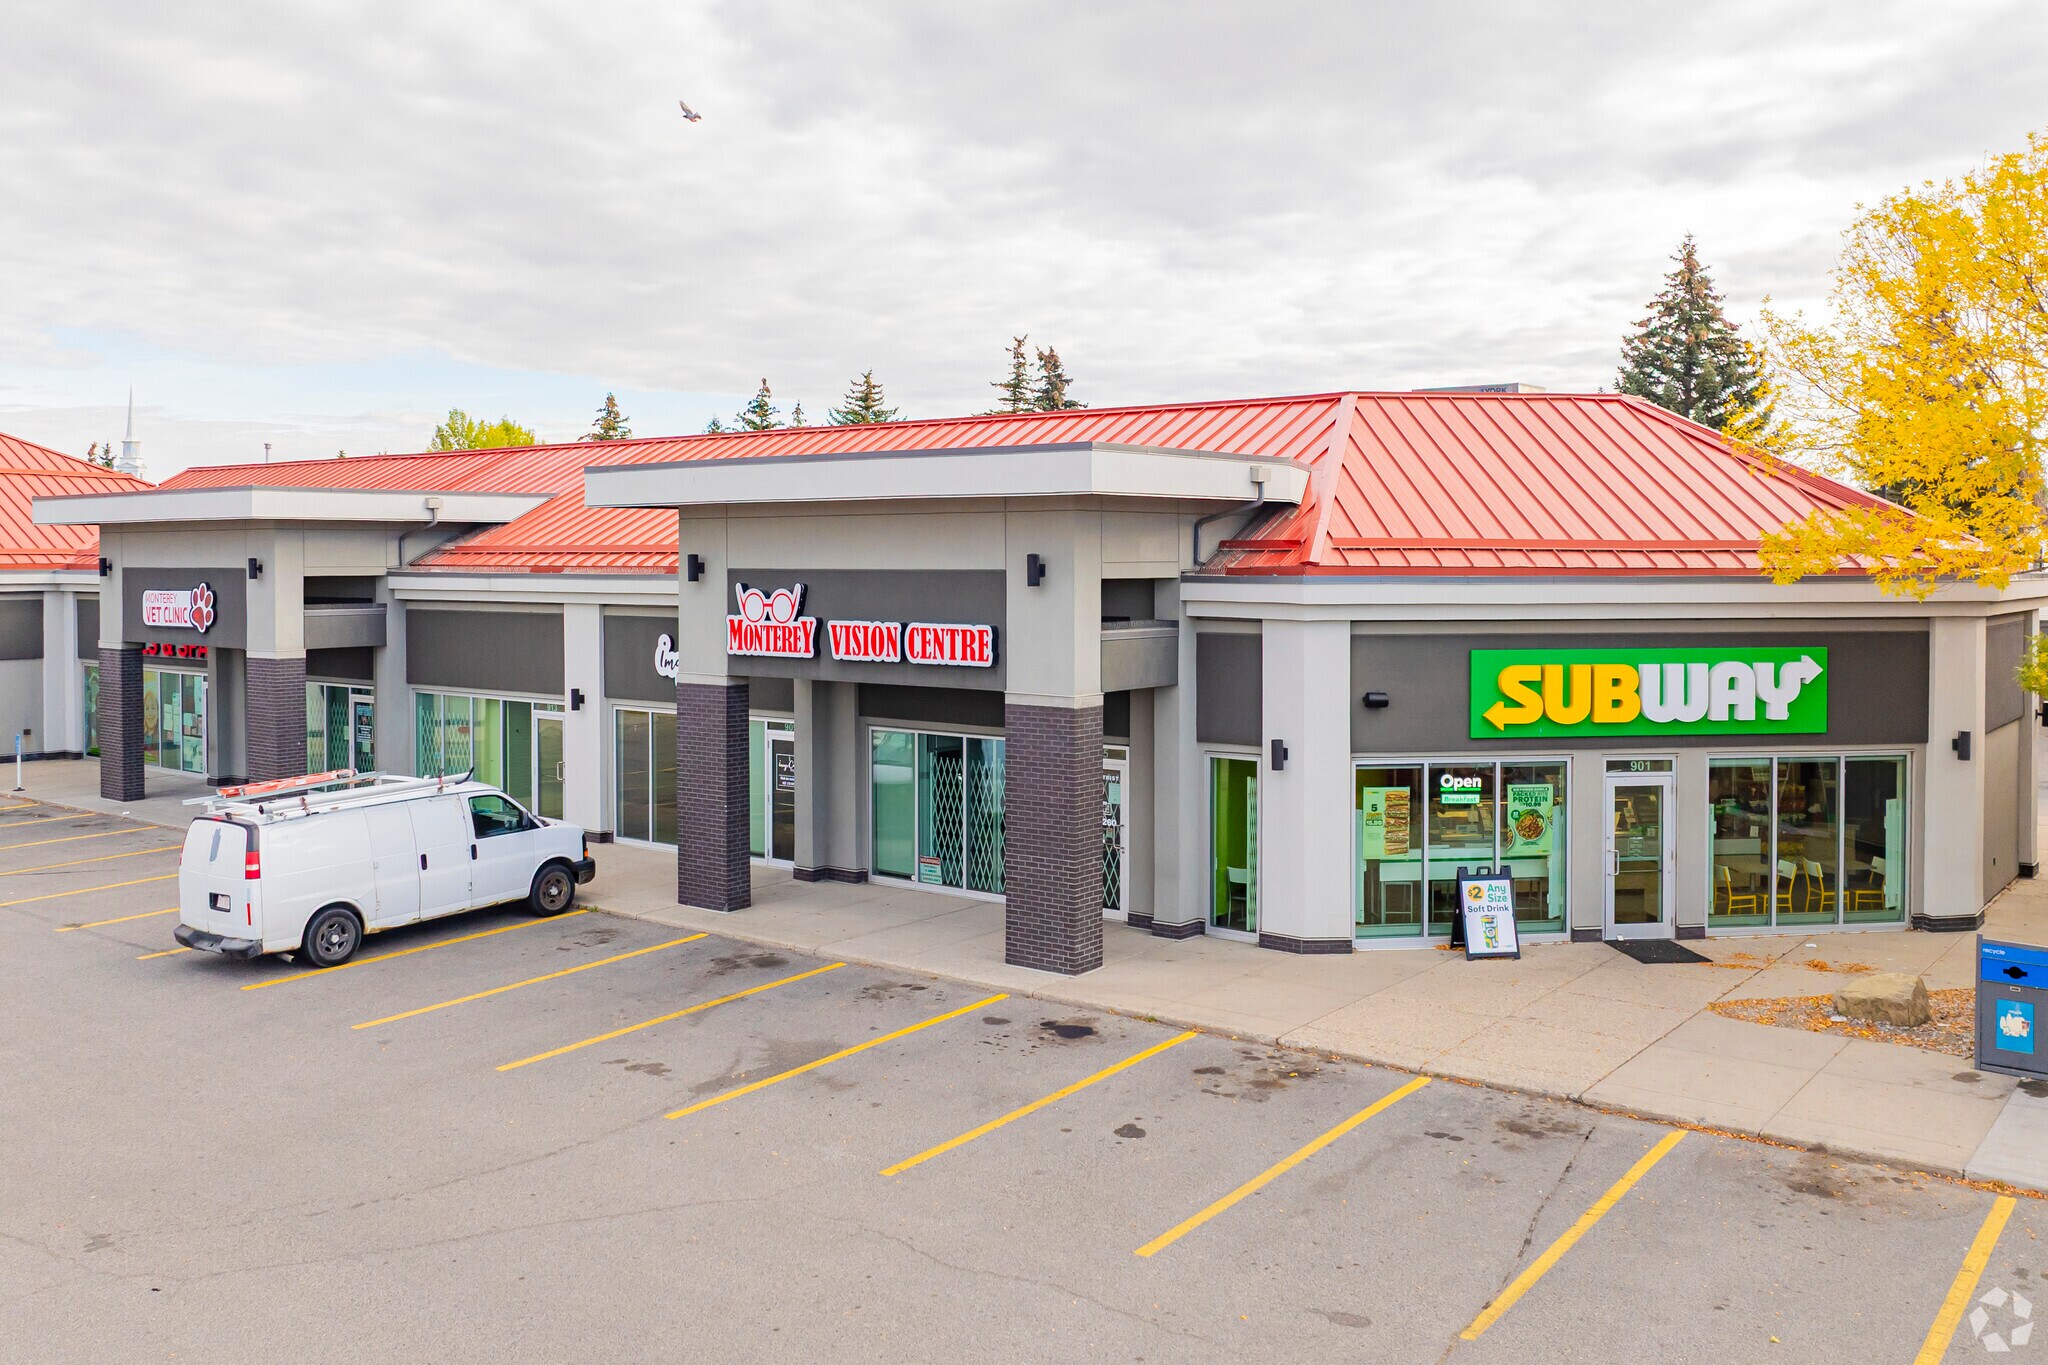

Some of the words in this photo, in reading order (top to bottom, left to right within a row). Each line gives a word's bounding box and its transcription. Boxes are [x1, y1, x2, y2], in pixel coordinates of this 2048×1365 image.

[145, 593, 177, 603] MONTEREY
[146, 606, 162, 622] VET
[164, 607, 188, 623] CLINIC
[728, 618, 814, 654] MONTEREY
[831, 623, 898, 658] VISION
[907, 626, 990, 663] CENTRE
[1482, 655, 1824, 732] SUBWAY
[1630, 760, 1651, 771] 901
[1440, 774, 1482, 791] Open
[1371, 804, 1378, 812] 5
[1468, 886, 1482, 899] $2
[1487, 883, 1506, 895] Any
[1487, 894, 1508, 903] Size
[1467, 905, 1486, 913] Soft
[1487, 904, 1510, 912] Drink
